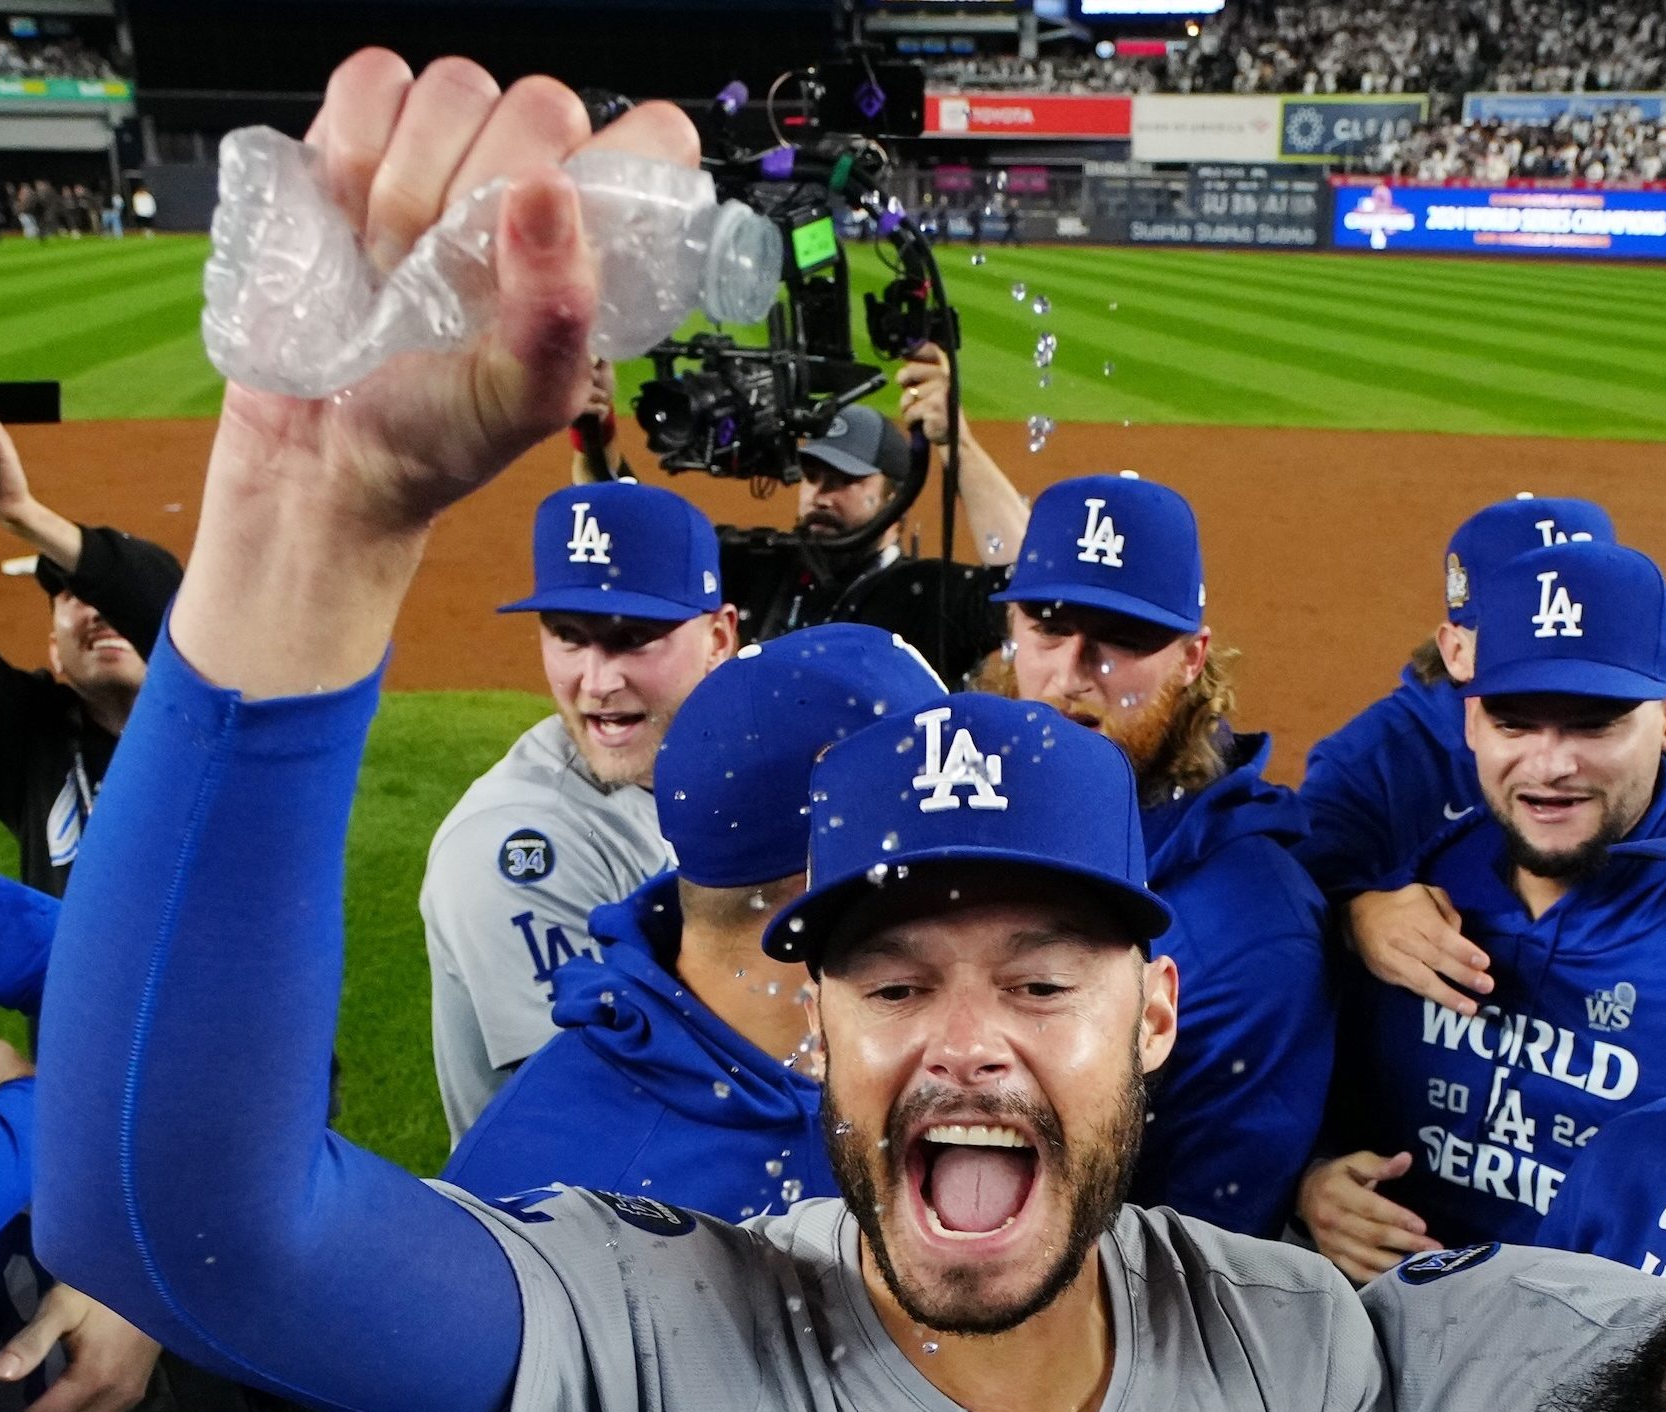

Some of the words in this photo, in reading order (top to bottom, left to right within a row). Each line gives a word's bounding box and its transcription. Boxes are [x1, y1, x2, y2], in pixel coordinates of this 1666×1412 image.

[567, 502, 611, 565] LA
[1077, 498, 1125, 568] LA
[1532, 571, 1583, 638] LA
[912, 707, 1009, 813] LA
[507, 848, 546, 876] 34
[1585, 996, 1631, 1032] WS
[1422, 999, 1640, 1101] WORLD
[1428, 1077, 1470, 1115] 20
[1418, 1125, 1567, 1216] SERIE
